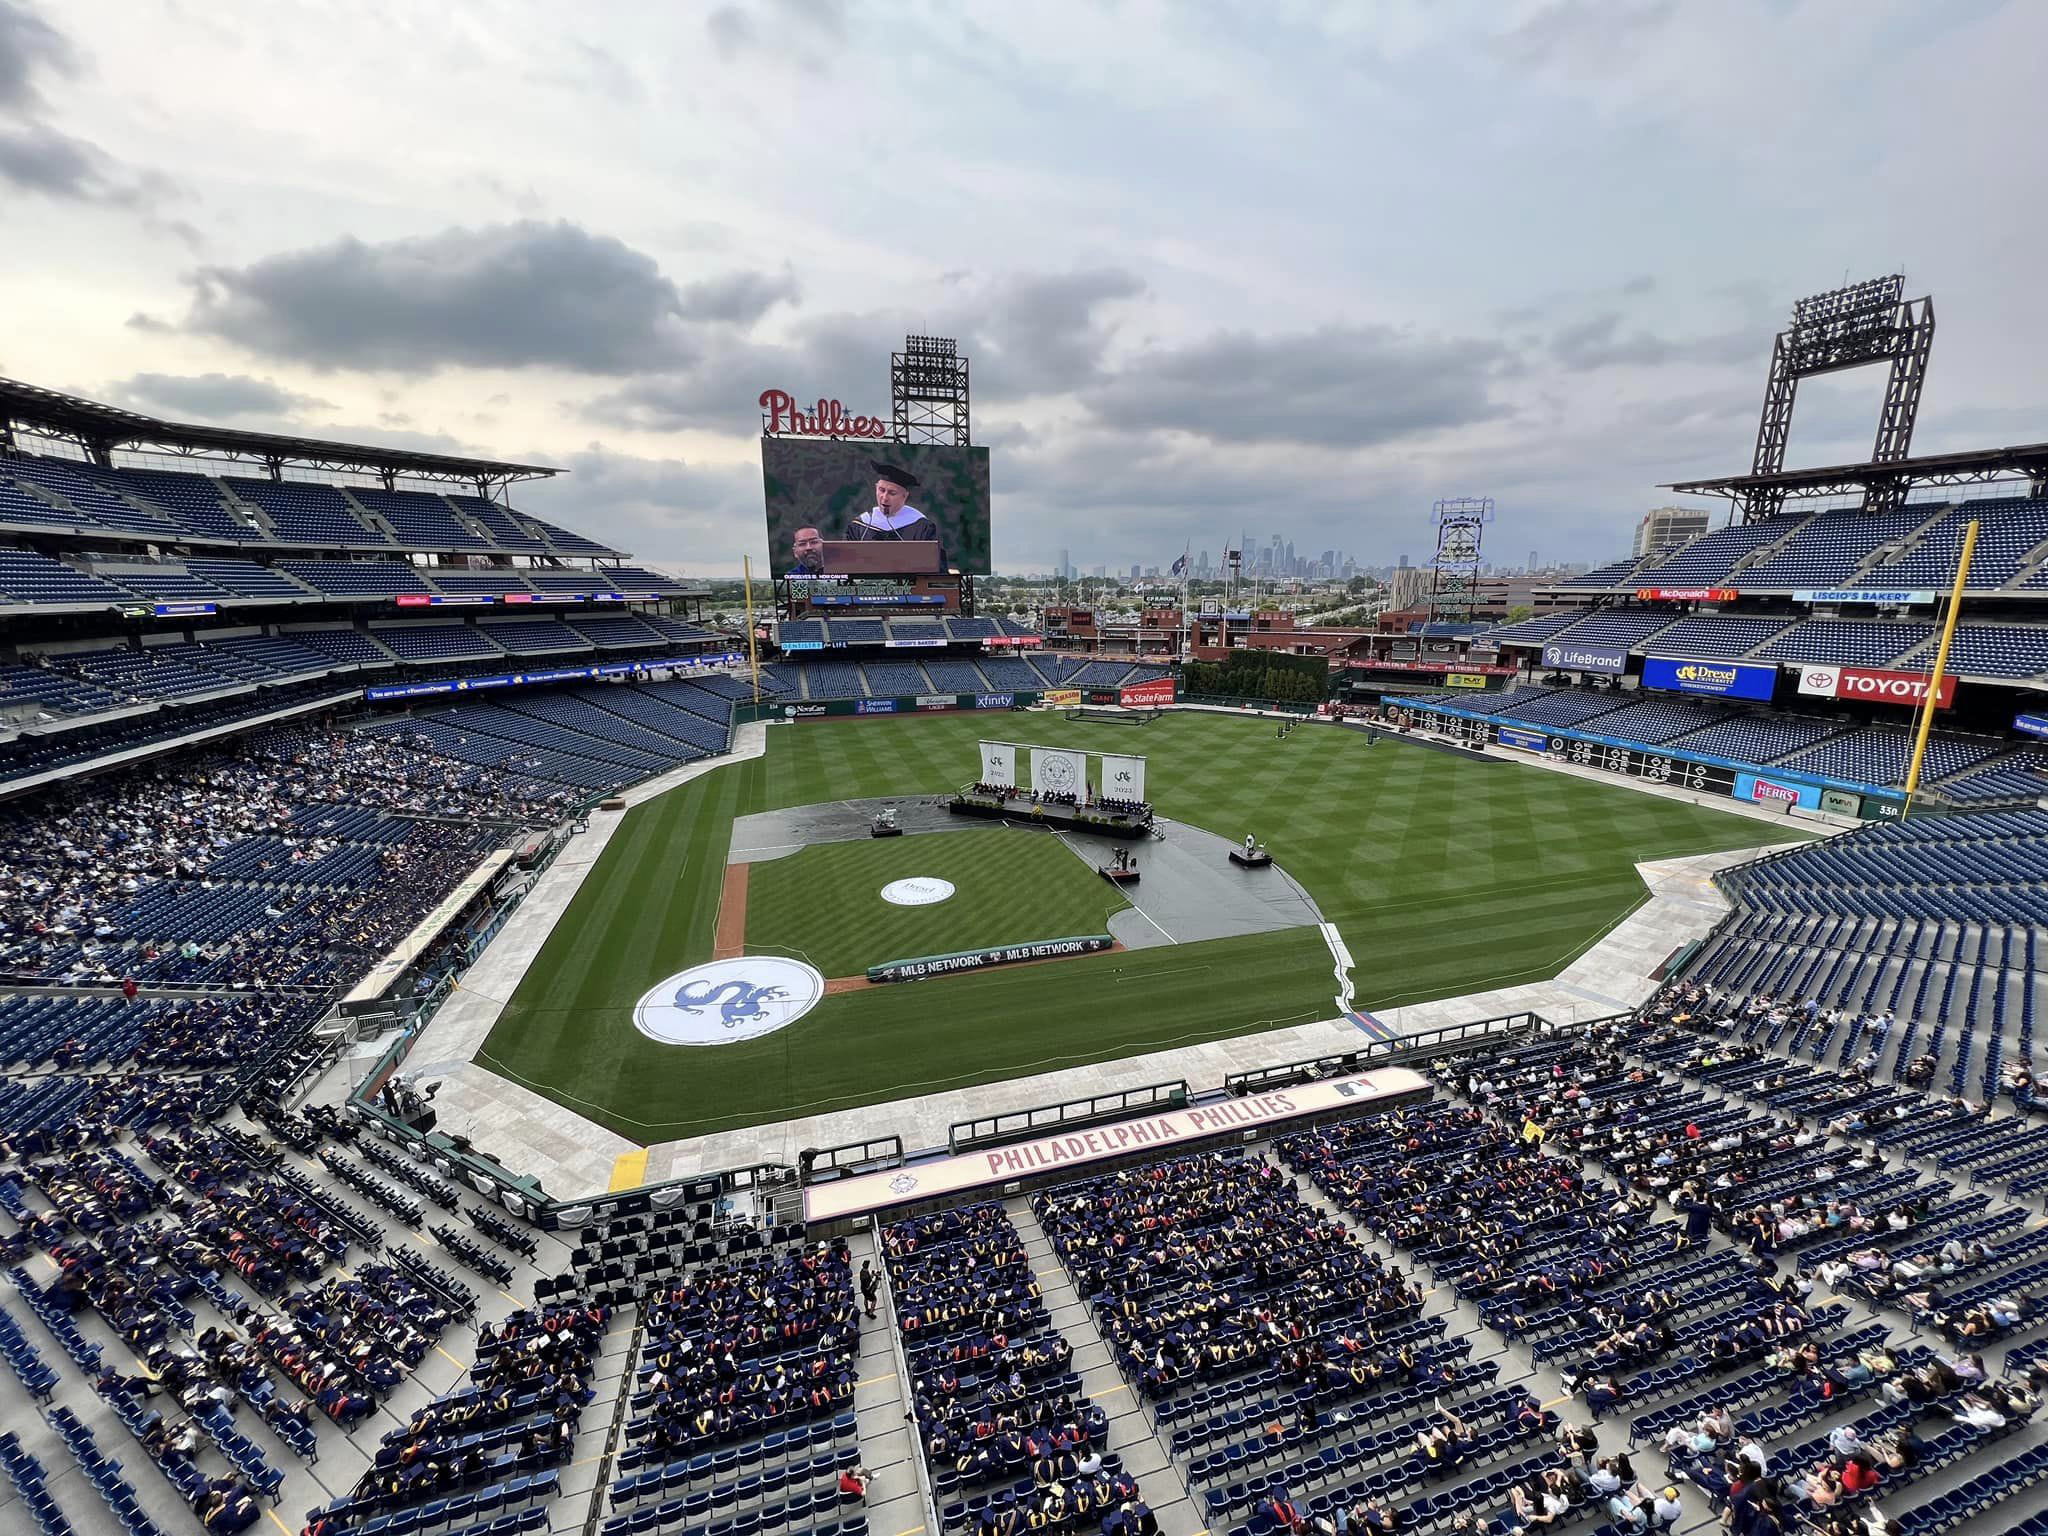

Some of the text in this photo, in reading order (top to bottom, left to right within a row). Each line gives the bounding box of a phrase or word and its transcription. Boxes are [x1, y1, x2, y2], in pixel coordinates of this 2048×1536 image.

[759, 389, 885, 438] Phillies
[1660, 590, 1710, 599] McDonald's
[1812, 592, 1911, 601] LISCIO'S BAKERY
[1564, 651, 1621, 667] LifeBrand
[1697, 666, 1736, 680] Drexel
[978, 695, 1011, 708] xfinity
[1006, 941, 1083, 961] MLB NETWORK
[901, 954, 983, 977] MLB NETWORK
[986, 1094, 1297, 1175] PHILADELPHIA PHILLIES
